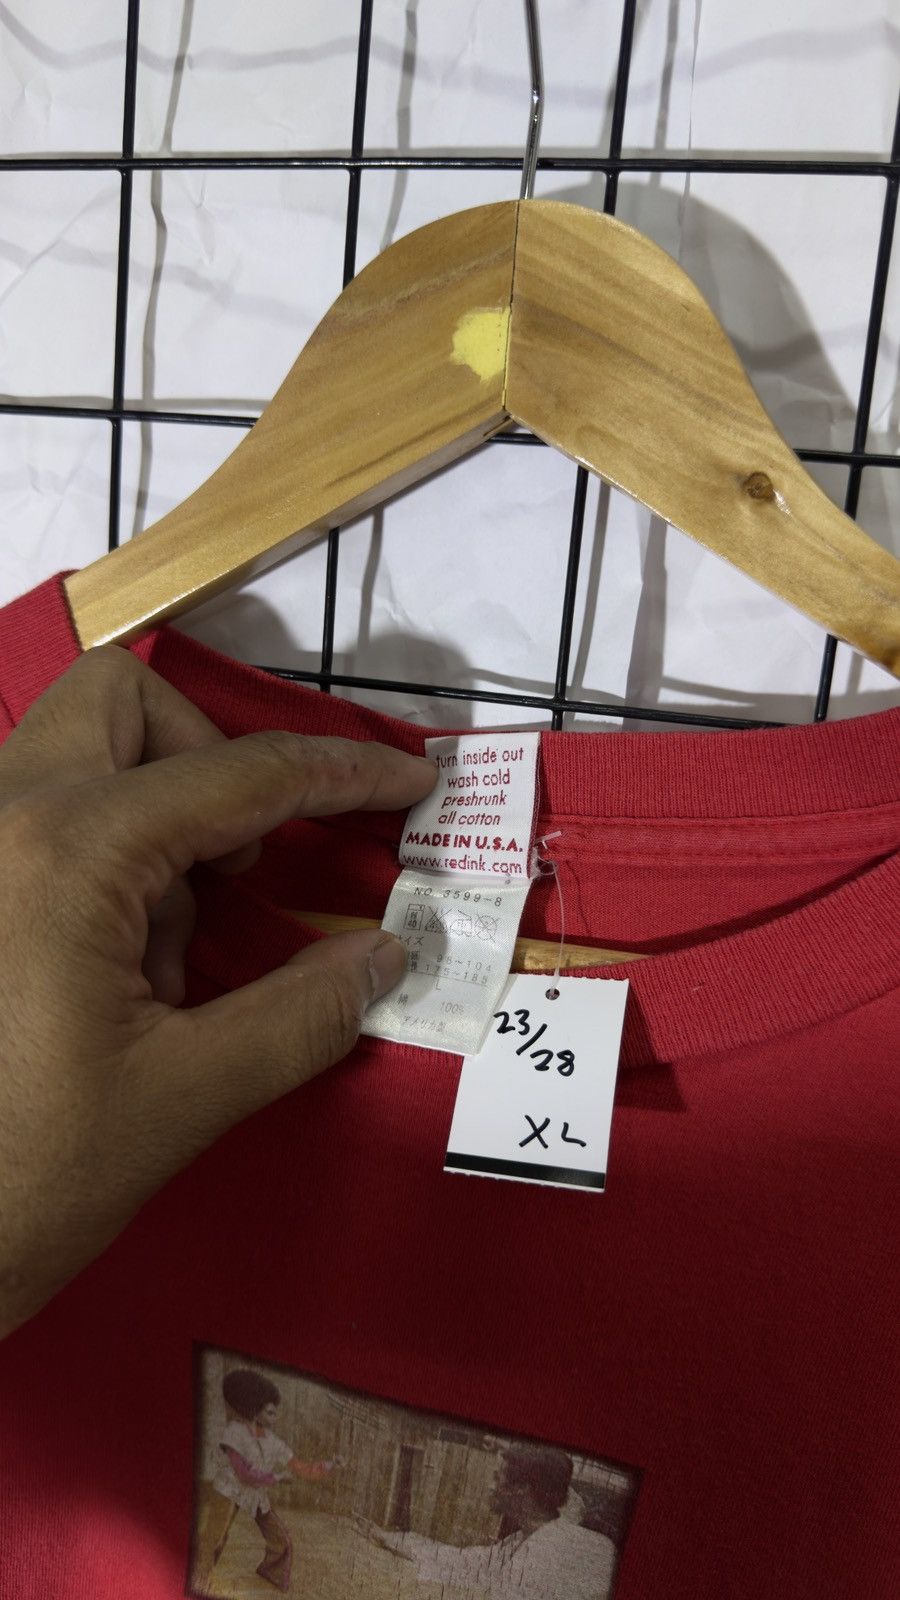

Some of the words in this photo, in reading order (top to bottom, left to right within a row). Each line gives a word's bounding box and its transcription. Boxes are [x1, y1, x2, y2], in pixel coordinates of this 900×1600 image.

[435, 754, 458, 768] turn
[462, 746, 498, 765] inside
[502, 747, 524, 762] out
[447, 770, 479, 788] wash
[482, 768, 511, 786] cold
[441, 790, 508, 809] preshrunk
[438, 810, 457, 825] all
[458, 812, 501, 826] cotton
[405, 831, 451, 847] MADE
[453, 834, 471, 848] IN
[474, 836, 524, 853] U.S.A.
[403, 854, 522, 873] www.redink.com
[442, 889, 503, 907] 3599-8
[398, 934, 423, 946] イズ
[518, 1114, 587, 1149] XL
